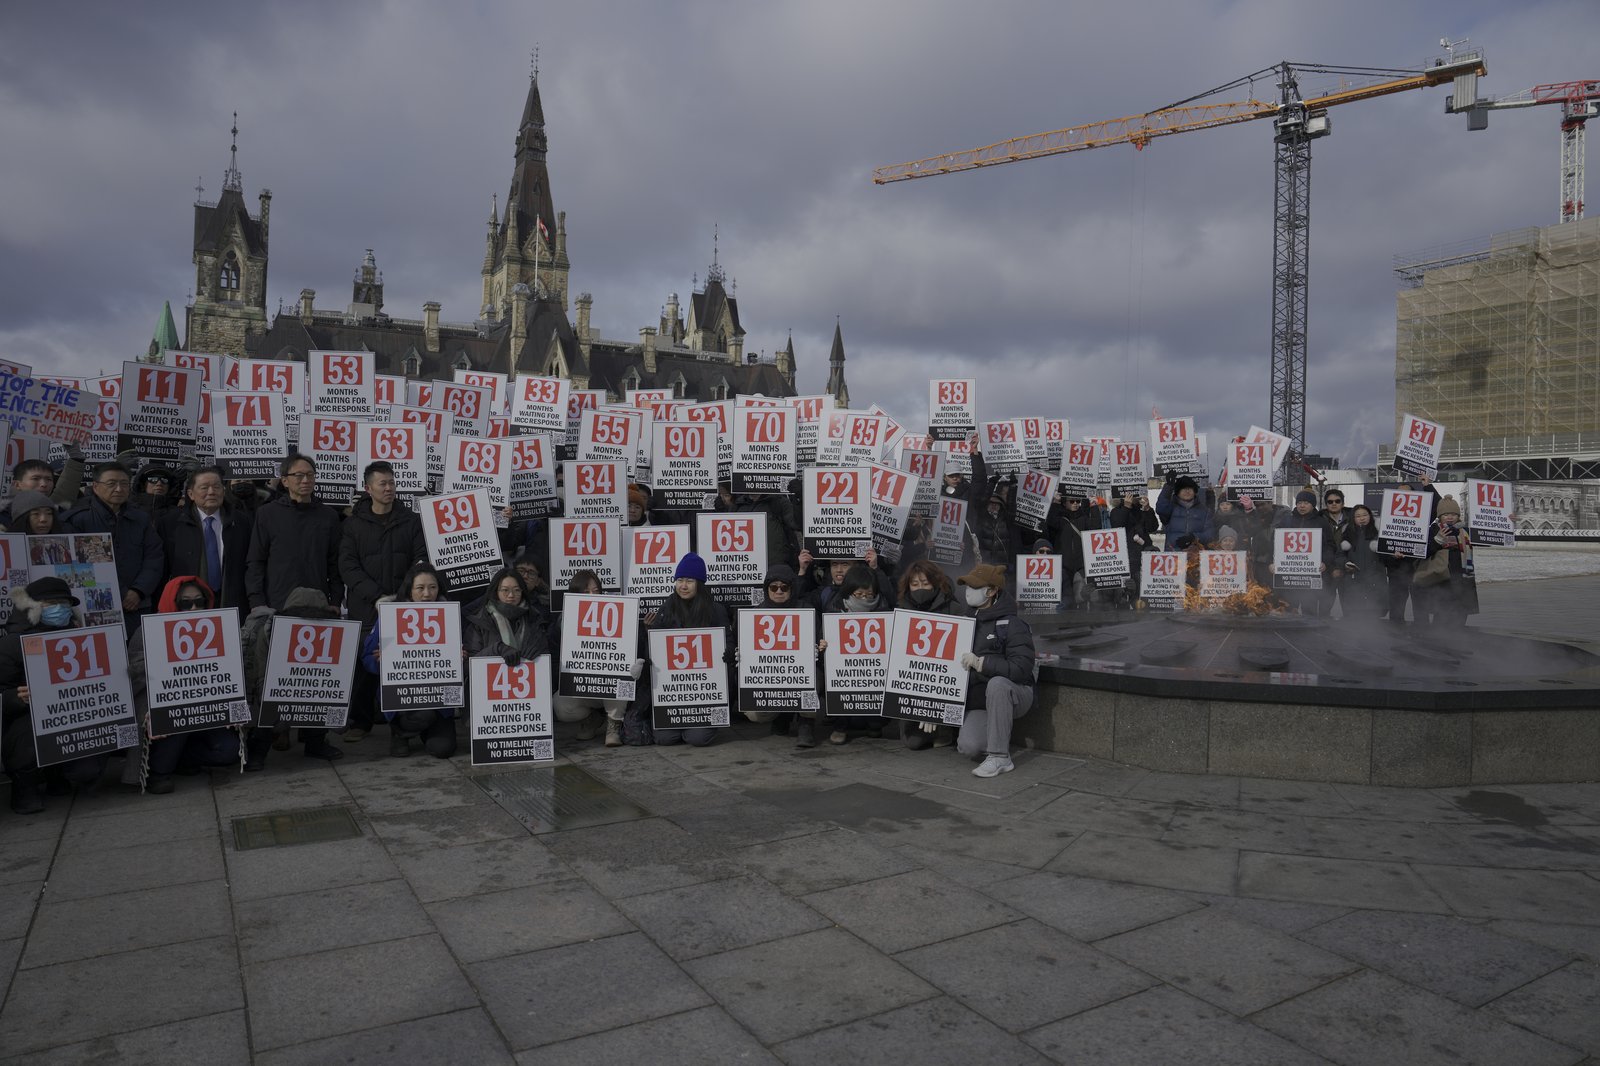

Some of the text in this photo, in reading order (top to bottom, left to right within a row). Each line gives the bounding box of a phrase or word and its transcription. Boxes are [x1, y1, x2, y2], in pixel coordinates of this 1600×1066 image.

[258, 366, 287, 392] 15
[329, 356, 358, 384] 53
[41, 383, 80, 407] THE
[144, 370, 179, 403] 11
[528, 379, 557, 403] 33
[943, 383, 964, 403] 38
[141, 406, 178, 417] MONTHS
[232, 397, 266, 425] 71
[448, 389, 476, 417] 68
[568, 394, 593, 417] 34
[798, 400, 820, 422] 11
[125, 424, 191, 436] IRCC RESPONSE
[131, 415, 187, 426] WAITING FOR
[596, 416, 625, 443] 55
[752, 413, 780, 441] 70
[320, 420, 350, 451] 53
[854, 419, 876, 445] 35
[991, 425, 1013, 442] 32
[1162, 422, 1184, 441] 31
[1412, 422, 1434, 443] 37
[376, 429, 408, 458] 63
[670, 428, 700, 457] 90
[464, 442, 496, 472] 68
[1072, 445, 1093, 465] 37
[1120, 445, 1139, 464] 37
[1238, 446, 1261, 465] 34
[662, 470, 708, 478] WAITING FOR
[913, 456, 932, 478] 31
[582, 465, 611, 494] 34
[822, 473, 853, 503] 22
[1027, 473, 1047, 494] 30
[1482, 485, 1502, 506] 14
[439, 496, 474, 532] 39
[1392, 495, 1418, 517] 25
[568, 524, 602, 554] 40
[717, 520, 748, 551] 65
[1096, 533, 1116, 553] 23
[1288, 532, 1309, 552] 39
[1395, 532, 1424, 540] RESPONSE
[640, 532, 671, 563] 72
[1029, 559, 1050, 579] 22
[1154, 556, 1175, 575] 20
[1214, 555, 1234, 575] 39
[403, 609, 440, 643] 35
[582, 602, 618, 636] 40
[174, 619, 217, 659] 62
[759, 616, 795, 649] 34
[845, 620, 880, 653] 36
[913, 620, 953, 657] 37
[295, 626, 333, 662] 81
[581, 641, 617, 651] MONTHS
[674, 635, 707, 669] 51
[56, 636, 103, 680] 31
[402, 650, 441, 659] MONTHS
[572, 651, 626, 662] WAITING FOR
[758, 655, 795, 663] MONTHS
[845, 659, 881, 667] MONTHS
[173, 663, 219, 677] MONTHS
[290, 668, 332, 678] MONTHS
[393, 660, 450, 670] WAITING FOR
[567, 661, 630, 672] IRCC RESPONSE
[750, 665, 804, 674] WAITING FOR
[836, 669, 887, 678] WAITING FO
[909, 661, 948, 674] MONTHS
[163, 673, 231, 690] WAITING FOR
[278, 678, 340, 689] WAITING FOR
[388, 670, 456, 681] IRCC RESPONSE
[493, 664, 530, 698] 43
[672, 673, 708, 682] MONTHS
[745, 676, 809, 684] IRCC RESPONSE
[832, 680, 850, 688] IRCC
[899, 670, 956, 686] WAITING FOR
[58, 683, 106, 700] MONTHS
[157, 684, 238, 703] IRCC RESPONSE
[271, 689, 344, 699] IRCC RESPONSE
[659, 692, 722, 703] IRCC RESPONSE
[663, 682, 717, 693] WAITING FOR
[753, 690, 801, 699] NO TIMELINES
[893, 680, 960, 697] IRCC RESPONSE
[48, 693, 119, 715] WAITING FOR
[169, 702, 229, 718] NO TIMELINES
[278, 704, 292, 713] NO
[492, 704, 530, 714] MONTHS
[770, 699, 798, 707] RESULTS
[43, 704, 127, 729] IRCC RESPONSE
[174, 711, 226, 727] NO RESULTS
[281, 713, 327, 721] NO RESULTS
[484, 714, 540, 725] WAITING FOR
[56, 724, 118, 745] NO TIMELINES
[479, 724, 545, 735] IRCC RESPONSE
[62, 734, 116, 754] NO RESULTS
